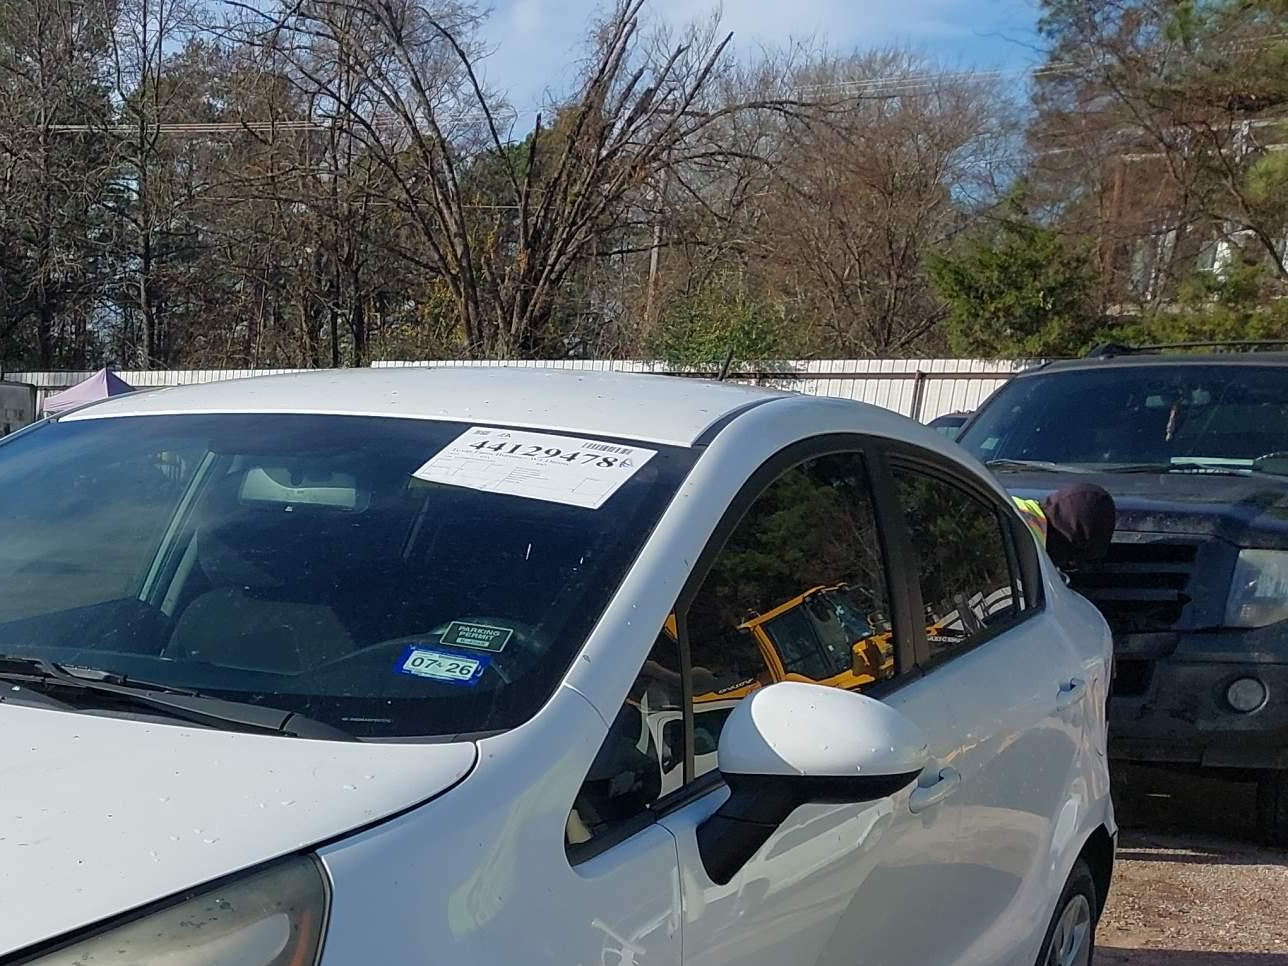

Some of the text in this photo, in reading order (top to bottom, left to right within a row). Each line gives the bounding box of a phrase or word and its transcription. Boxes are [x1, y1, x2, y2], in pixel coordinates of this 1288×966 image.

[469, 440, 619, 468] 44129478
[458, 626, 501, 637] PARKING
[458, 631, 494, 641] PERMIT
[411, 657, 439, 669] 07
[445, 662, 473, 675] 26
